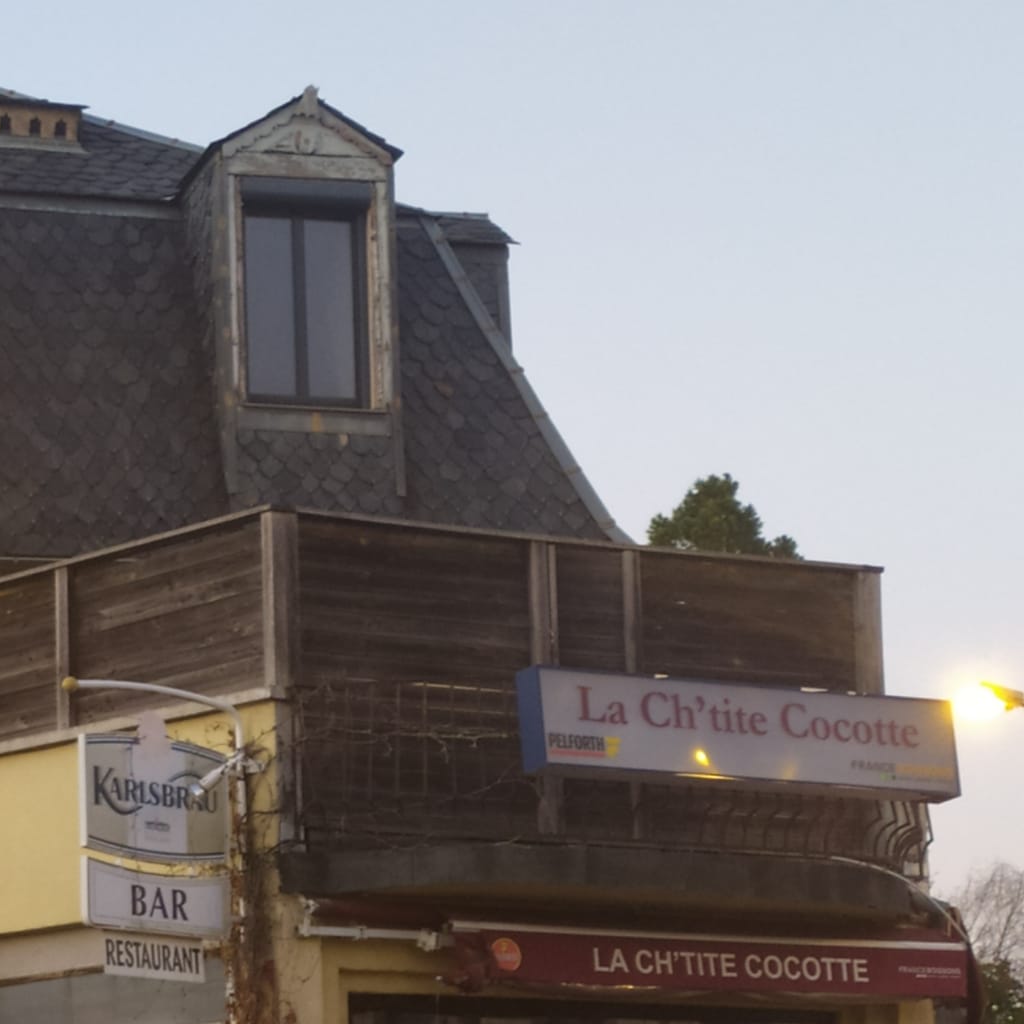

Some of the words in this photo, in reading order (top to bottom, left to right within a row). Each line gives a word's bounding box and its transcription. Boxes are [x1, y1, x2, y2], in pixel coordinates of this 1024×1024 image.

[577, 685, 628, 725] La
[640, 691, 769, 736] Ch'tite
[779, 702, 920, 749] Cocotte
[548, 732, 605, 752] PELFORTH
[131, 884, 189, 921] BAR
[105, 938, 201, 975] RESTAURANT
[592, 947, 630, 974] LA
[634, 949, 739, 979] CH'TITE
[744, 954, 870, 984] COCOTTE
